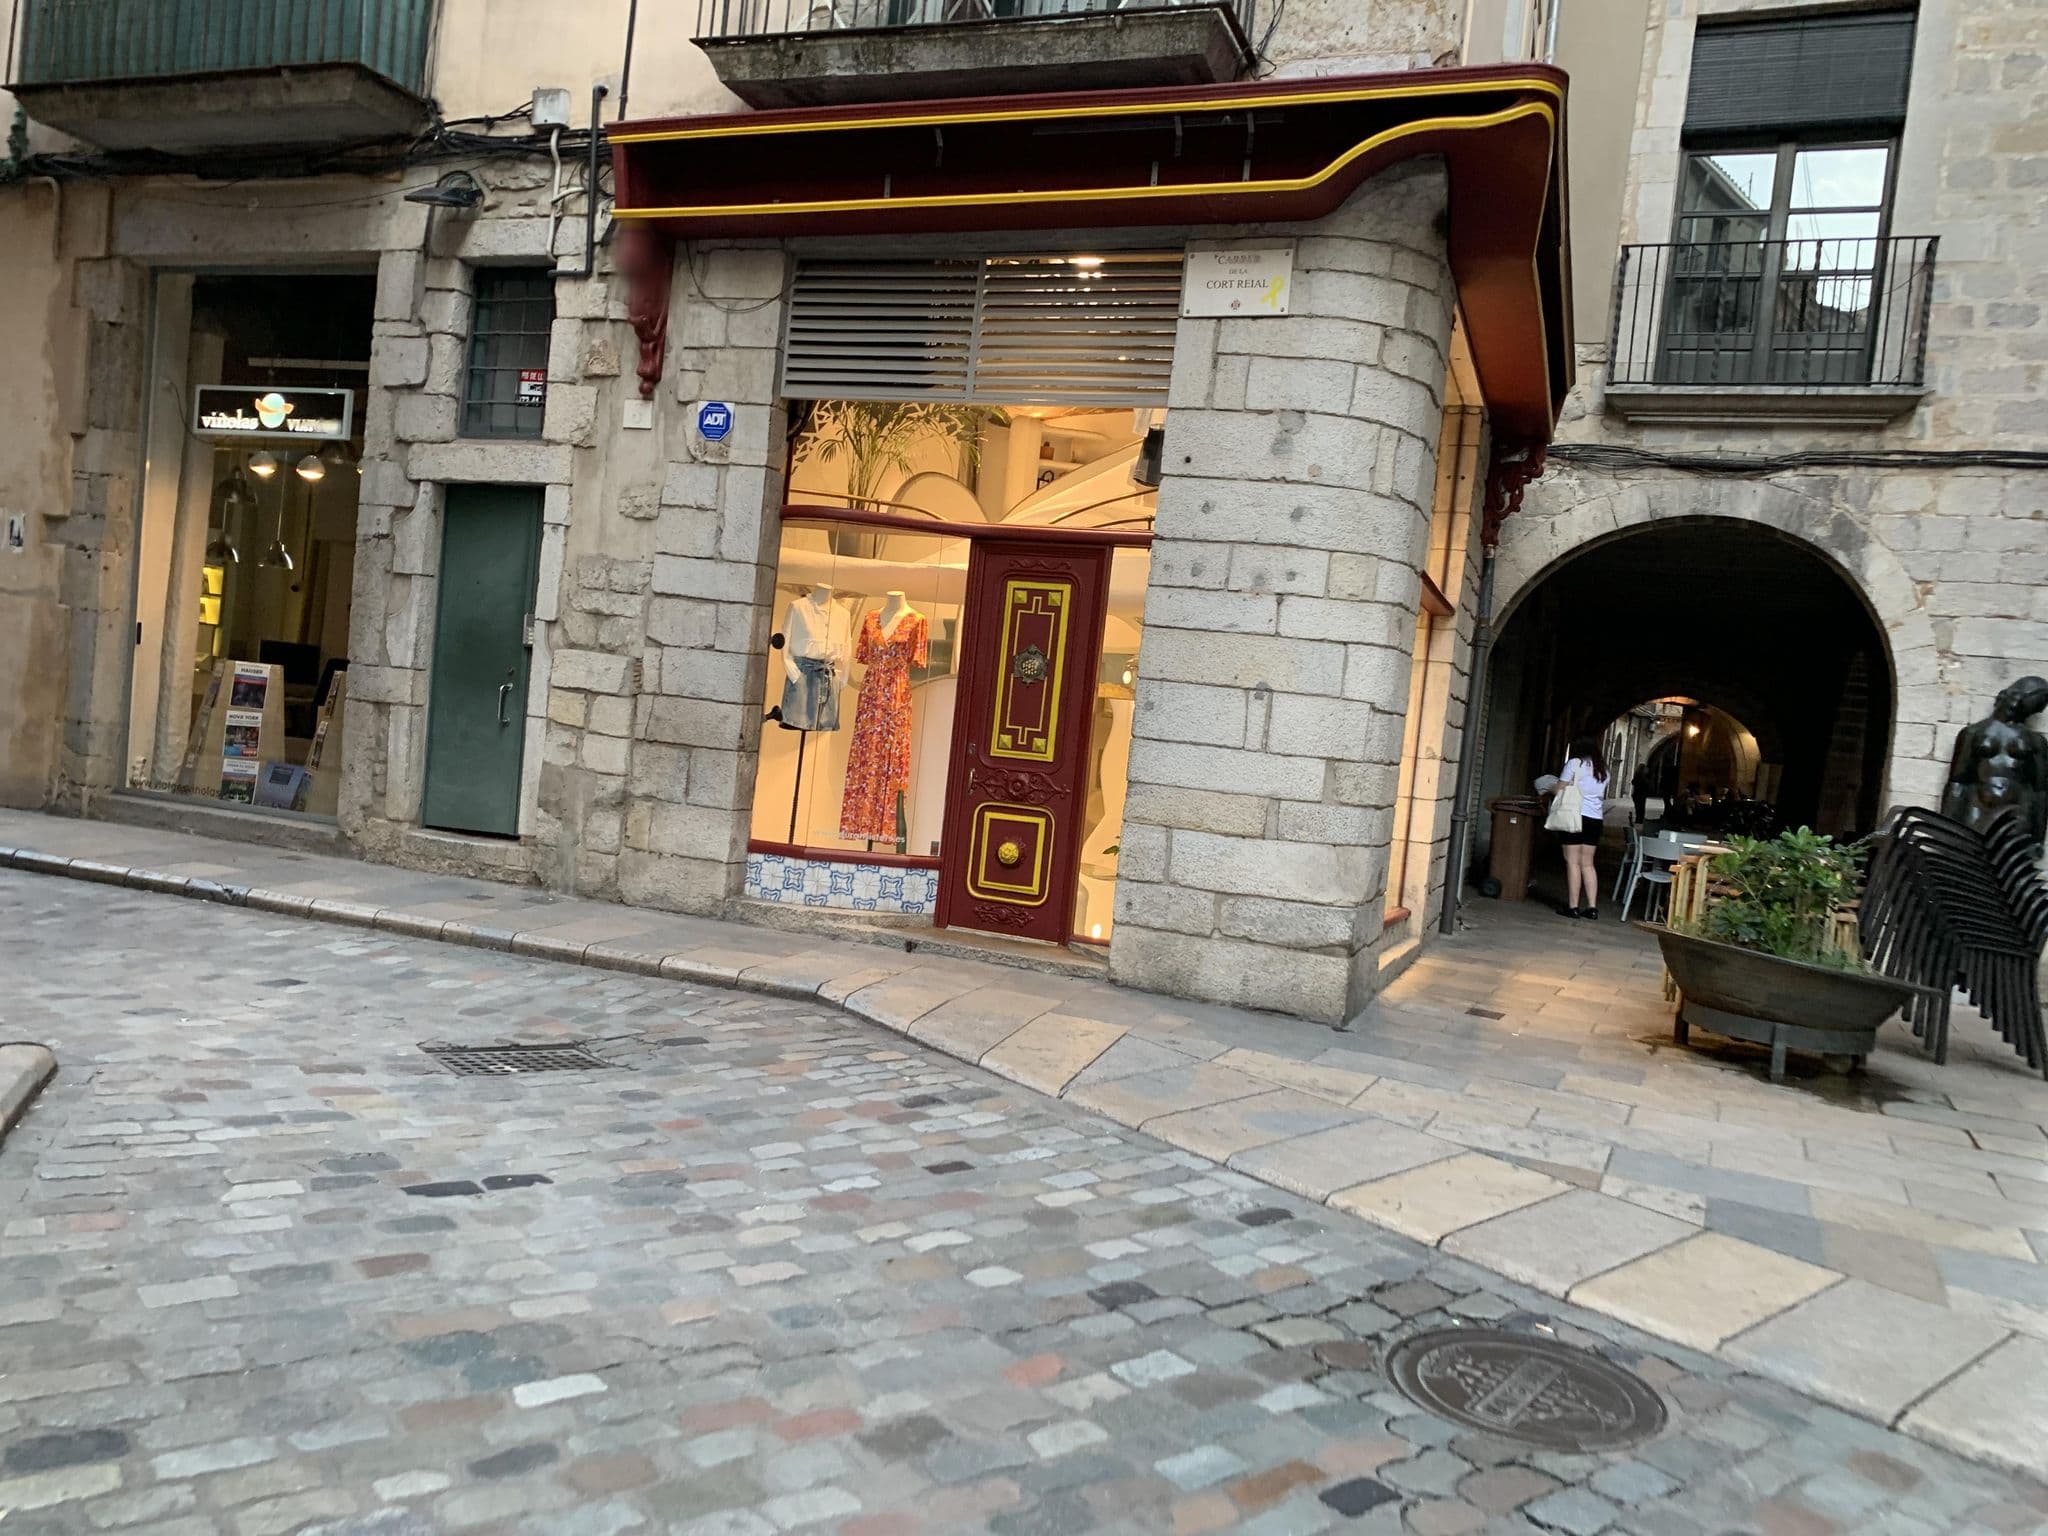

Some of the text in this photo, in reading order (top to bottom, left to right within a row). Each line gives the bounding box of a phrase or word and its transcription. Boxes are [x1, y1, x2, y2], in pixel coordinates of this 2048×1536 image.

[1206, 279, 1269, 290] CORT REIAL
[703, 412, 727, 426] ADT
